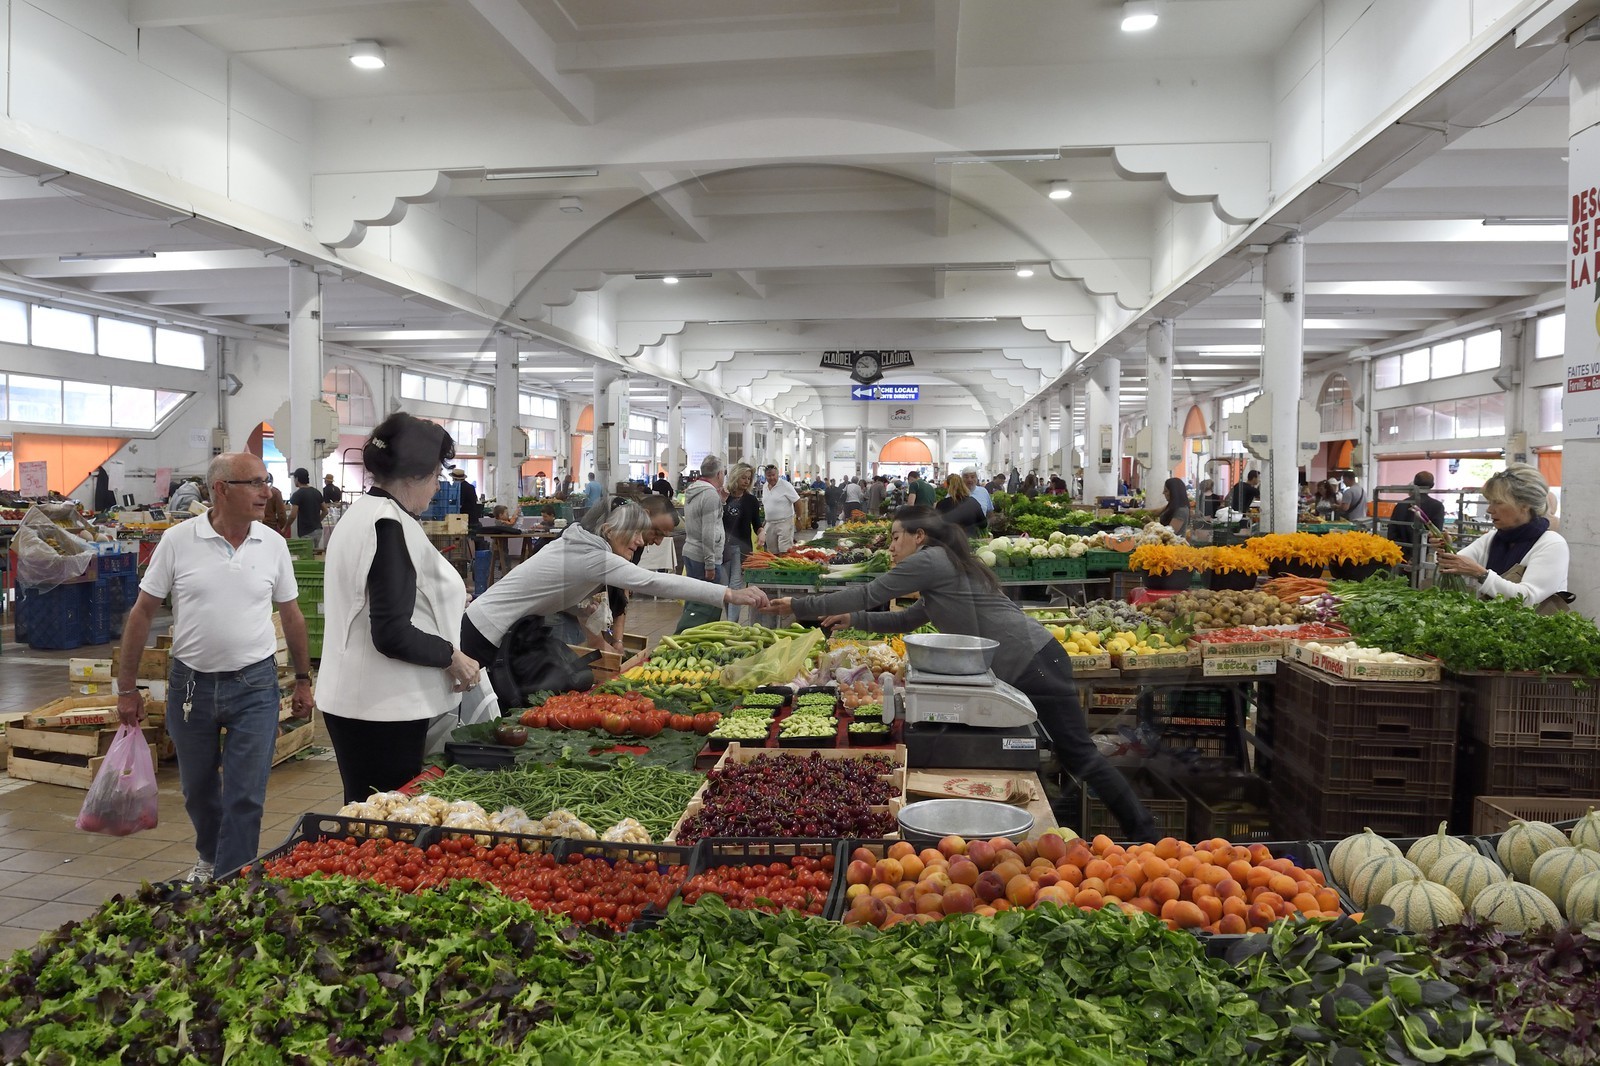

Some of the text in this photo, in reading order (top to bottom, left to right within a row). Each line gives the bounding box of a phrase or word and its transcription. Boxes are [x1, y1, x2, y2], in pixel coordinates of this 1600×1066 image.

[1572, 222, 1589, 256] SE
[1571, 256, 1591, 289] LA
[823, 352, 852, 366] CLAUDEL
[881, 352, 911, 366] CLAUDEL
[1568, 363, 1590, 378] FAITES
[1569, 379, 1587, 391] Forville
[1217, 662, 1250, 670] ROCCA
[1311, 652, 1319, 666] La
[60, 716, 71, 725] La
